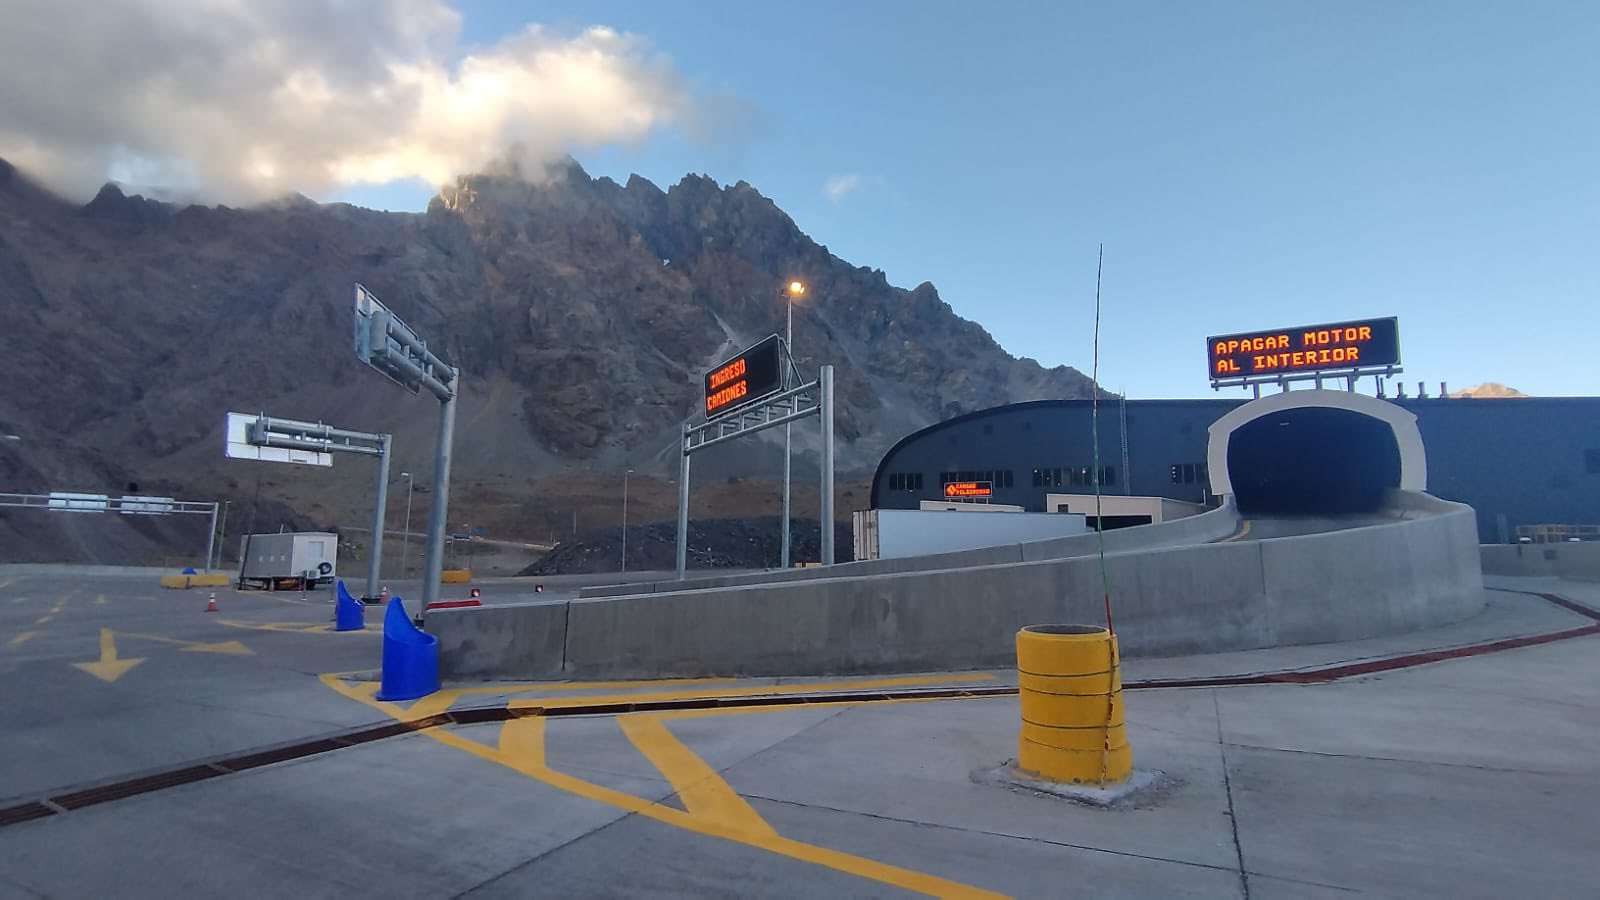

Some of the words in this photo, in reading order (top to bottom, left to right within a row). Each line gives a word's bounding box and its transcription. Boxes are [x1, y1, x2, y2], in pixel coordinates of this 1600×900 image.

[1215, 335, 1290, 354] APAGAR
[1304, 326, 1372, 345] MOTOR
[710, 358, 746, 389] INGRESO
[1217, 359, 1240, 372] AL
[1254, 347, 1359, 369] INTERIOR
[707, 380, 747, 411] CAMIONES
